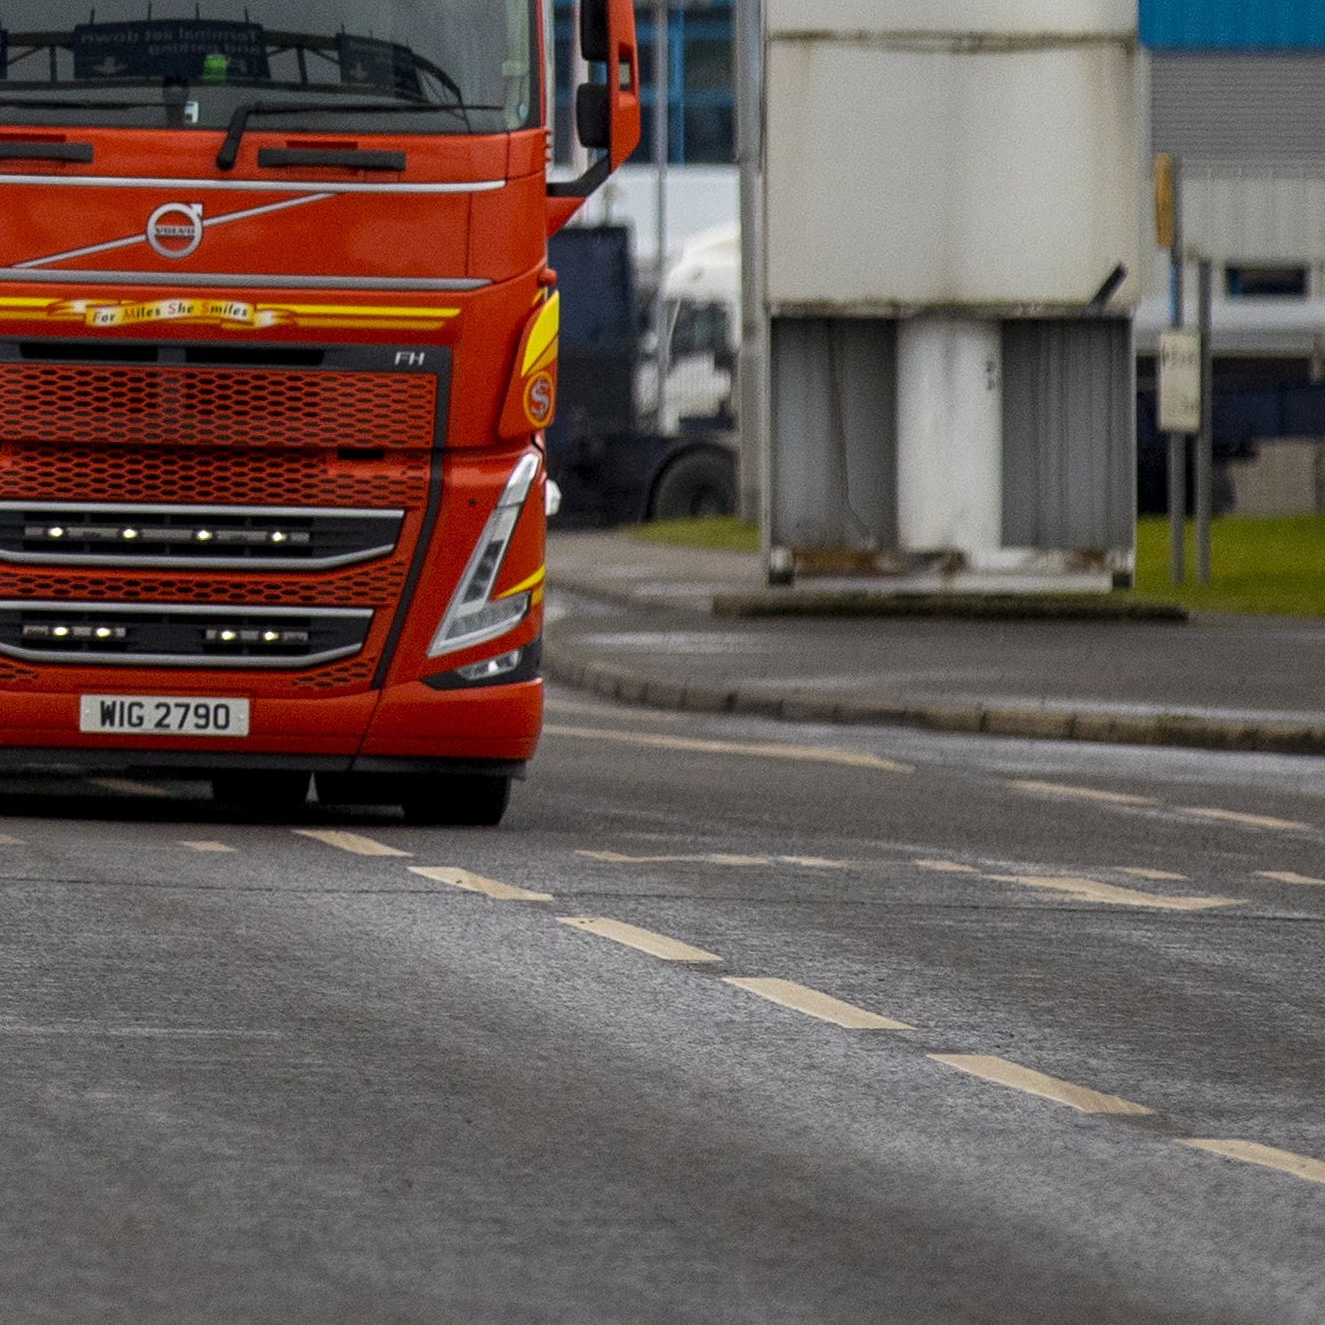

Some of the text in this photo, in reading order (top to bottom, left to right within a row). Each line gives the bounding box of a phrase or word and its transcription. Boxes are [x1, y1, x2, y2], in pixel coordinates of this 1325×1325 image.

[154, 226, 196, 238] VOLVO
[92, 301, 249, 323] For Miles She Smiles
[393, 350, 426, 367] FH
[99, 700, 231, 731] WIG 2790
